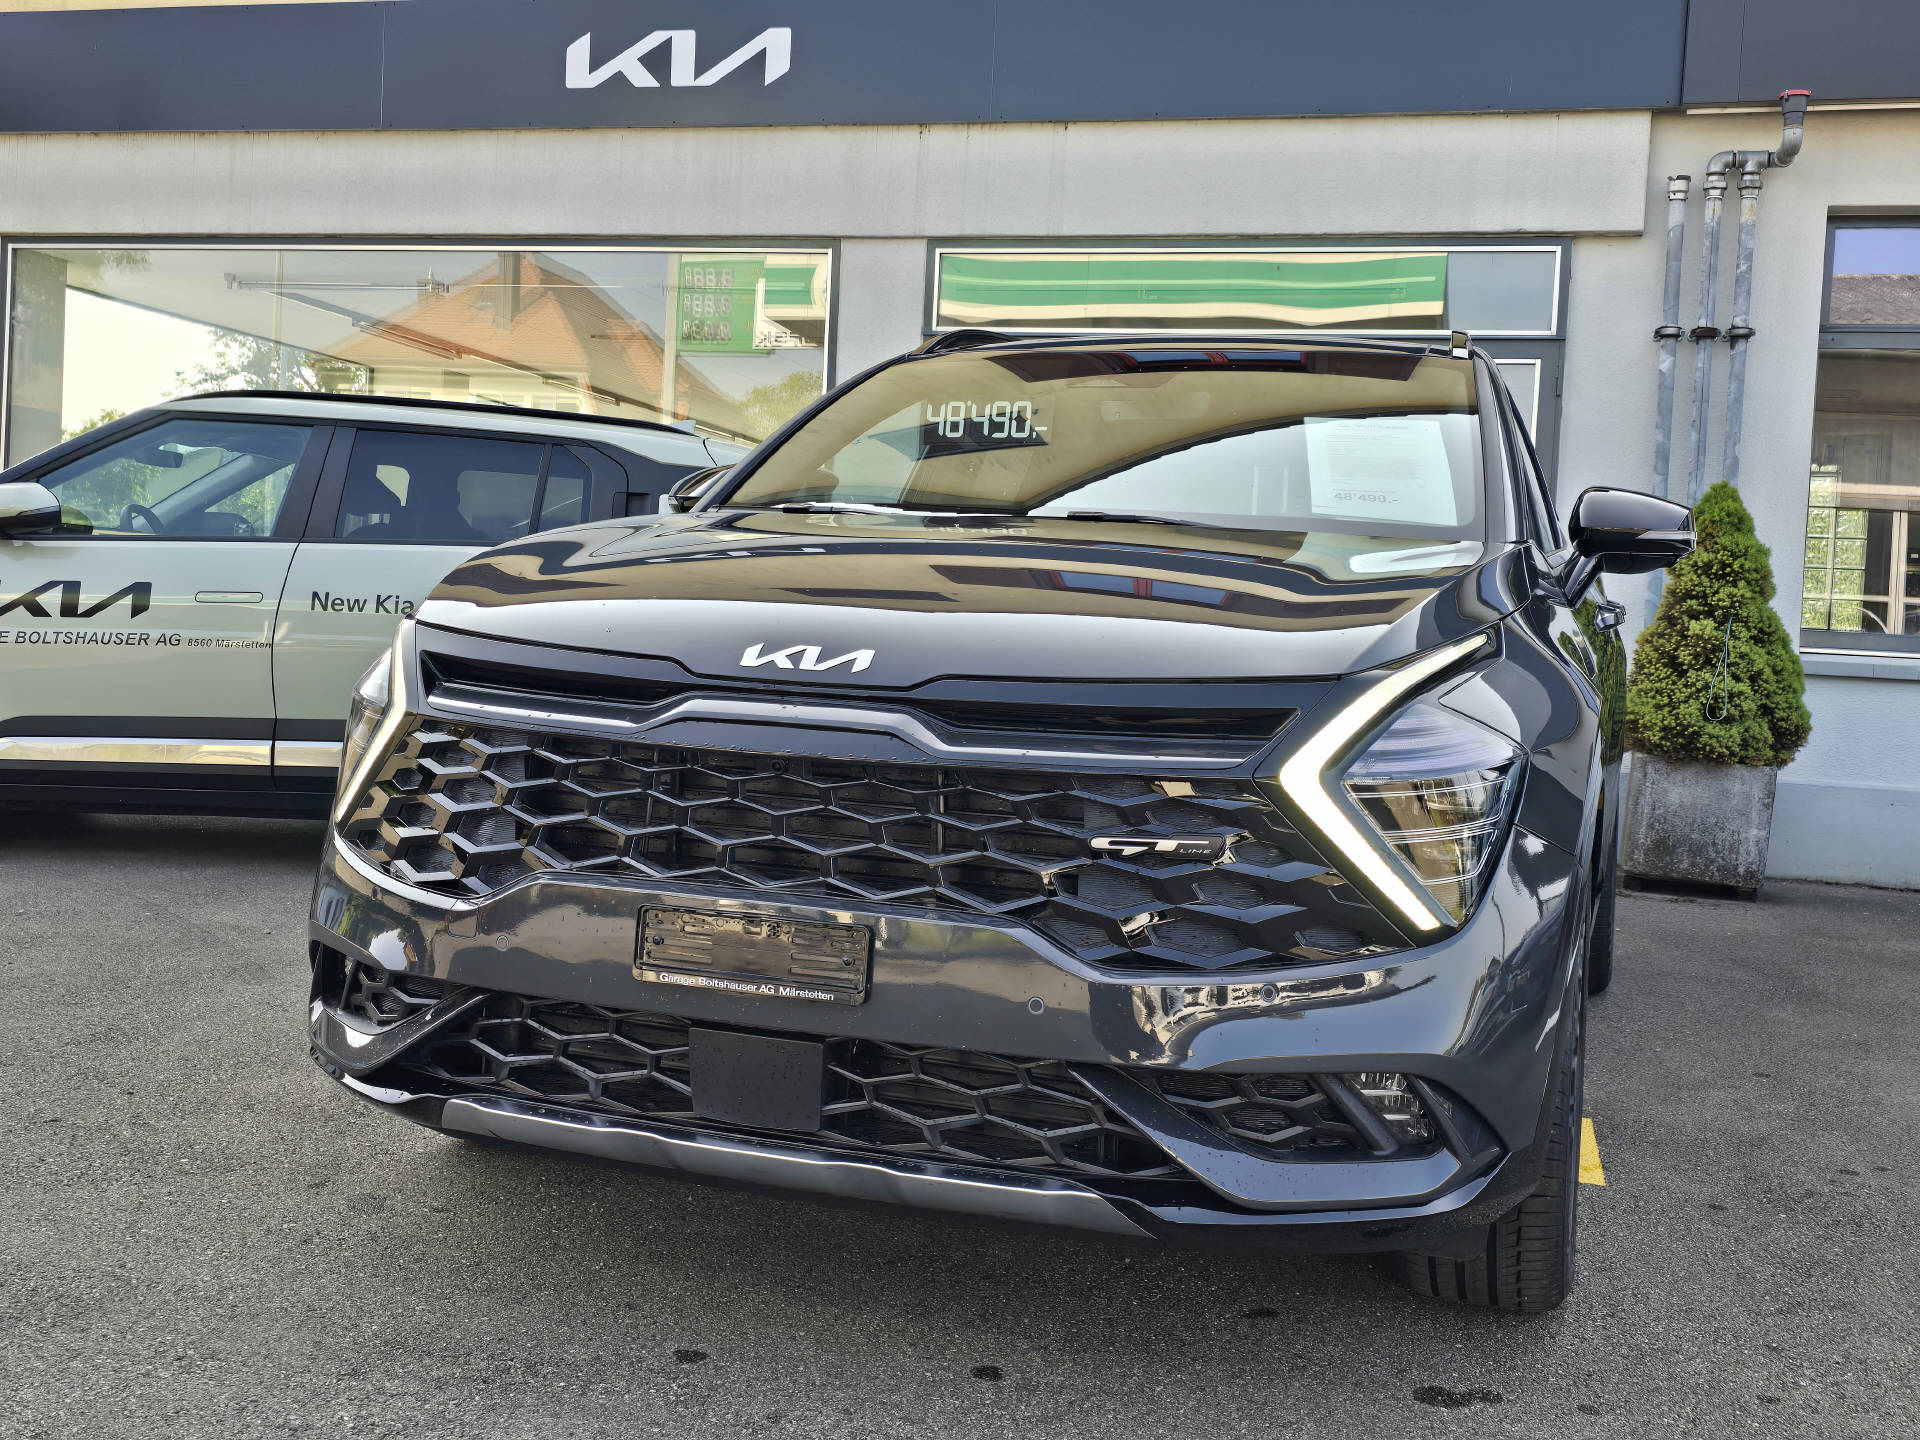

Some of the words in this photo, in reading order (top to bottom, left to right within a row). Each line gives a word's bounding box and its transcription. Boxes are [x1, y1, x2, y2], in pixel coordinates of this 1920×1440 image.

[565, 27, 792, 89] KIA
[310, 591, 368, 612] New
[375, 594, 415, 616] Kia
[14, 631, 151, 646] BOLTSHAUSER
[155, 633, 182, 647] AG
[187, 638, 213, 648] 8560
[215, 639, 272, 649] Märstetten
[739, 642, 876, 674] KIA
[659, 973, 696, 986] Garage
[698, 976, 758, 993] Boltshauser
[759, 984, 776, 995] AG
[779, 986, 834, 1001] Märstetten
